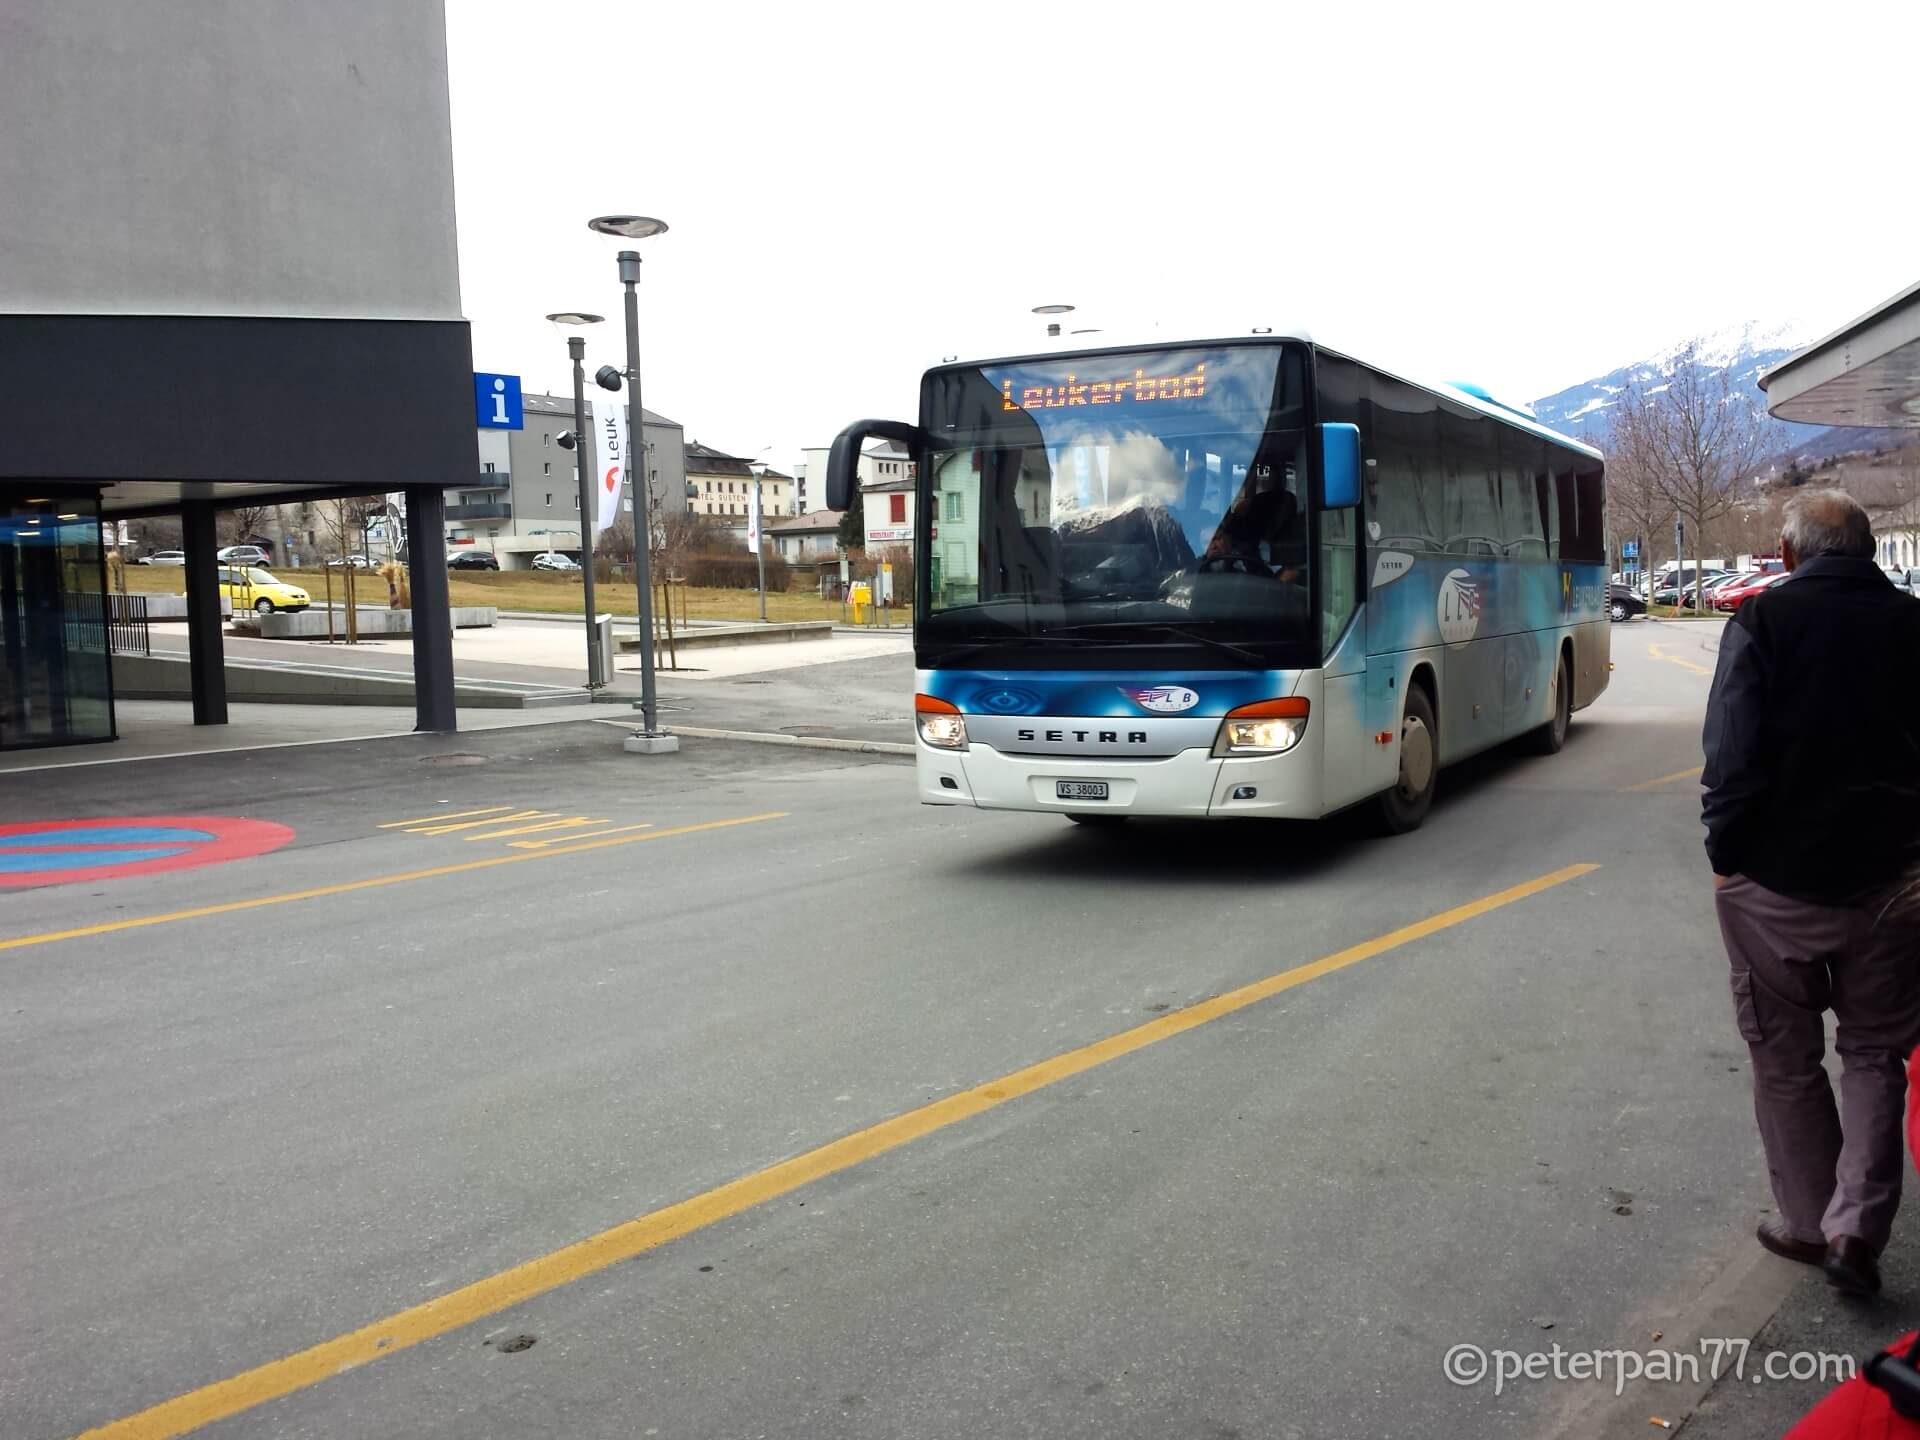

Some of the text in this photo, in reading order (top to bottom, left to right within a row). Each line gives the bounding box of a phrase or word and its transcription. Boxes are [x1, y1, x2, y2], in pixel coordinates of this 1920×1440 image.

[604, 416, 621, 461] Leuk
[1016, 729, 1148, 744] SETRA
[1059, 783, 1105, 796] VS 38003
